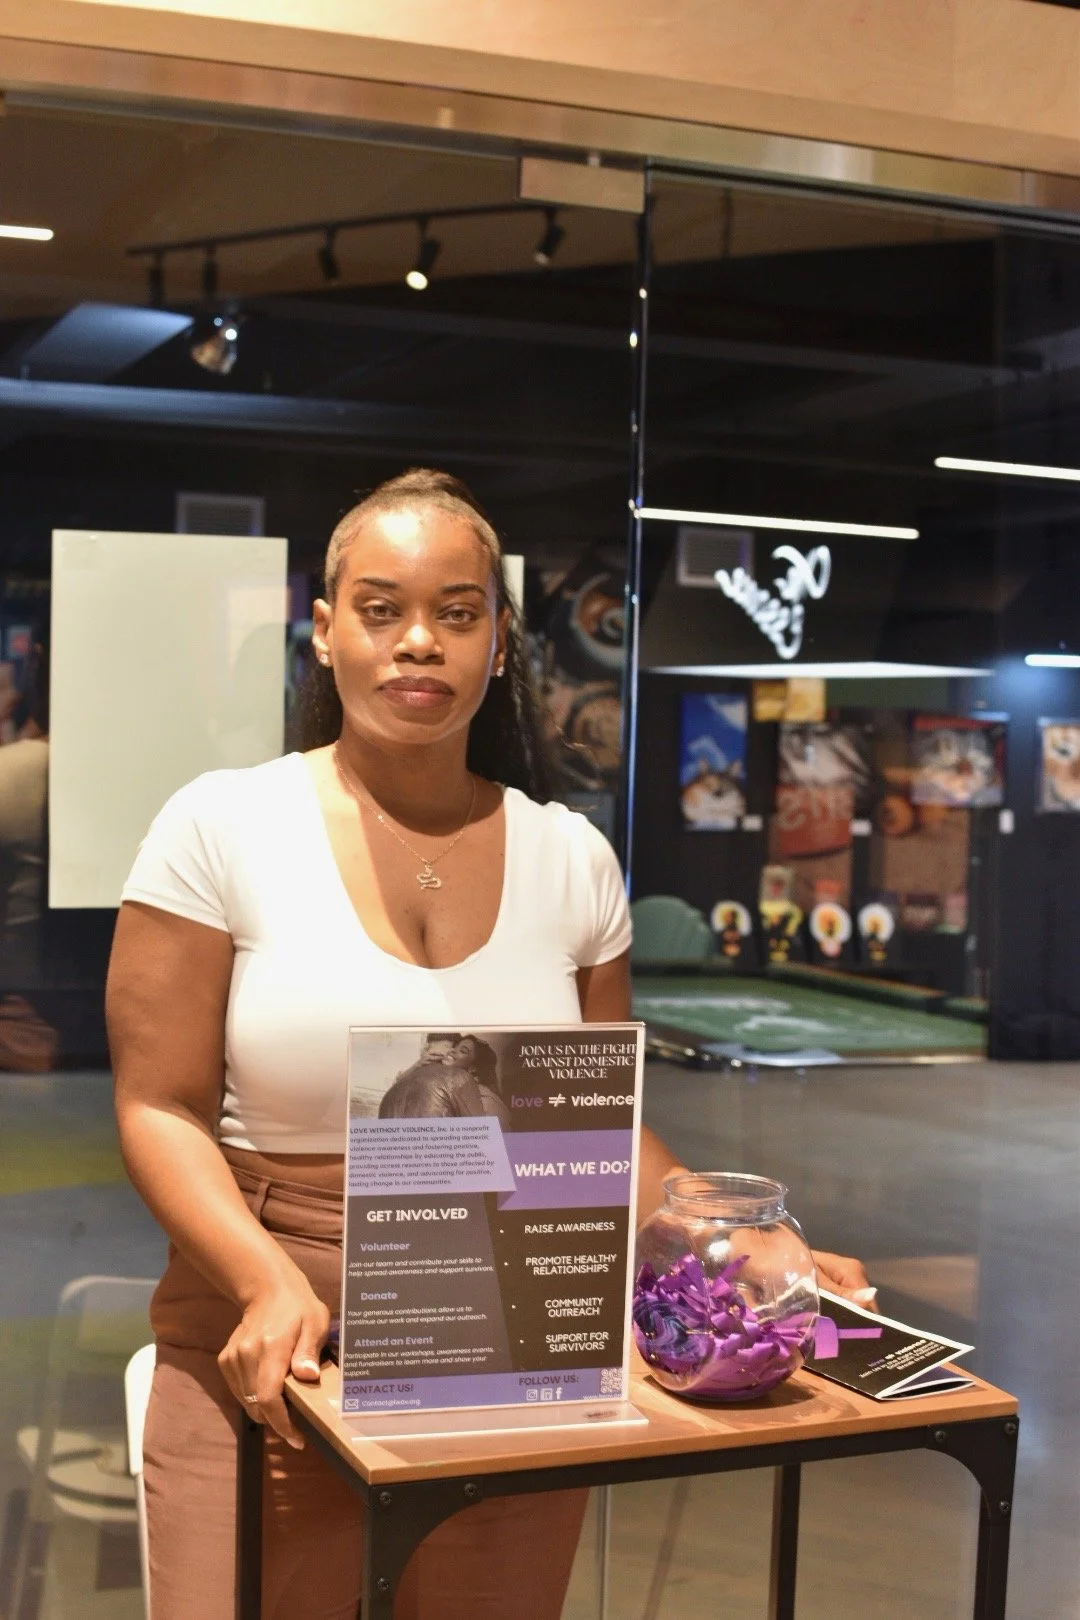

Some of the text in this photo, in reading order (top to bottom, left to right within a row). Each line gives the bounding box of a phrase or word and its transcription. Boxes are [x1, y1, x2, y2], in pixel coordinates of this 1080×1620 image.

[519, 1043, 637, 1057] JOIN US IN THE FIGHT
[522, 1056, 635, 1068] AGAINST DOMESTIC
[549, 1068, 608, 1079] VIOLENCE
[511, 1095, 543, 1108] love
[571, 1092, 634, 1107] violence
[514, 1160, 631, 1177] WHAT WE DO?
[366, 1208, 468, 1222] GET INVOLVED
[524, 1221, 616, 1234] RAISE AWARENESS
[360, 1243, 410, 1252] Volunteer
[525, 1254, 617, 1266] PROMOTE HEALTHY
[533, 1264, 609, 1275] RELATIONSHIPS
[360, 1291, 398, 1301] Donate
[545, 1297, 604, 1309] COMMUNITY
[548, 1307, 600, 1318] OUTREACH
[354, 1336, 434, 1347] Attend an Event
[545, 1331, 609, 1344] SUPPORT FOR
[549, 1341, 605, 1353] SURVIVORS
[519, 1375, 579, 1385] FOLLOW US:
[344, 1384, 414, 1394] CONTACT US!
